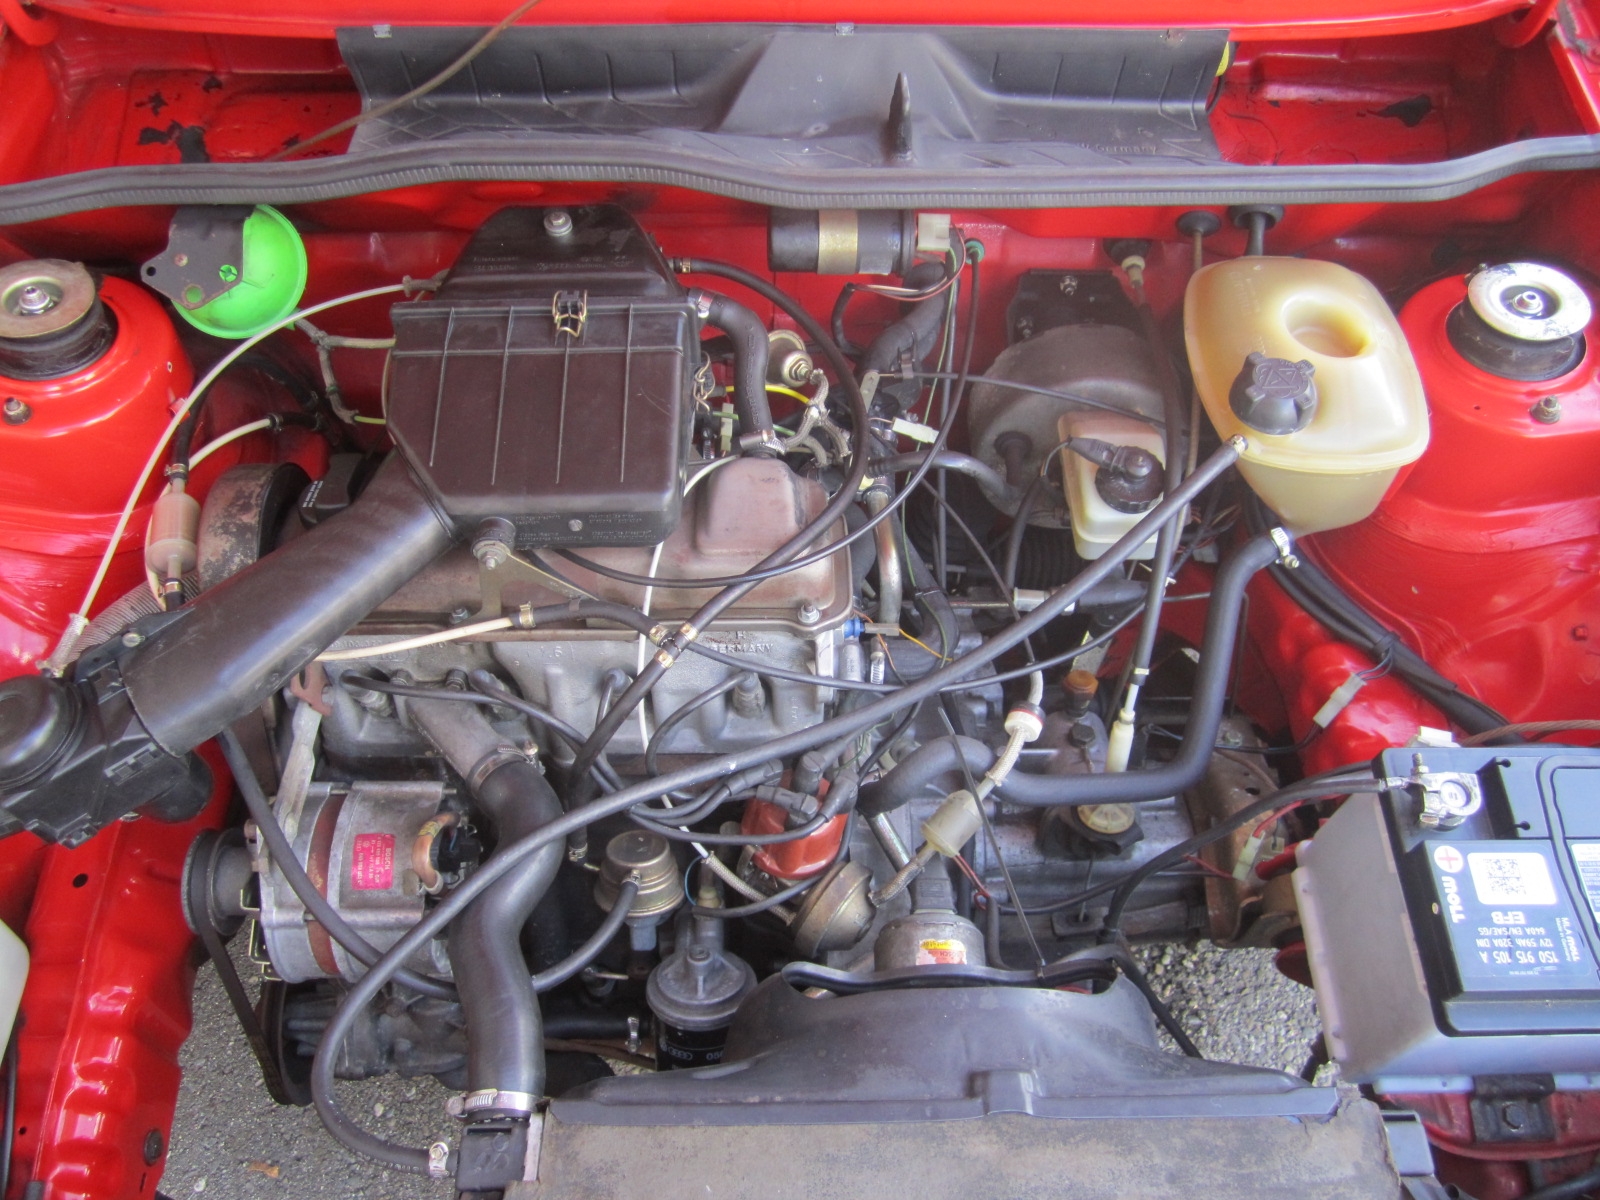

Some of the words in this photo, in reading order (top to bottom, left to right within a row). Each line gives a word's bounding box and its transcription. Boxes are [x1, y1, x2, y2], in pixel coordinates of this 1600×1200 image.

[384, 847, 392, 870] BOSCH
[1490, 911, 1526, 925] EFB
[1525, 926, 1546, 936] 640A
[1475, 937, 1490, 947] DIN
[1539, 937, 1553, 947] 12V
[1478, 951, 1489, 964] A
[1492, 950, 1512, 964] 105
[1515, 950, 1535, 964] 915
